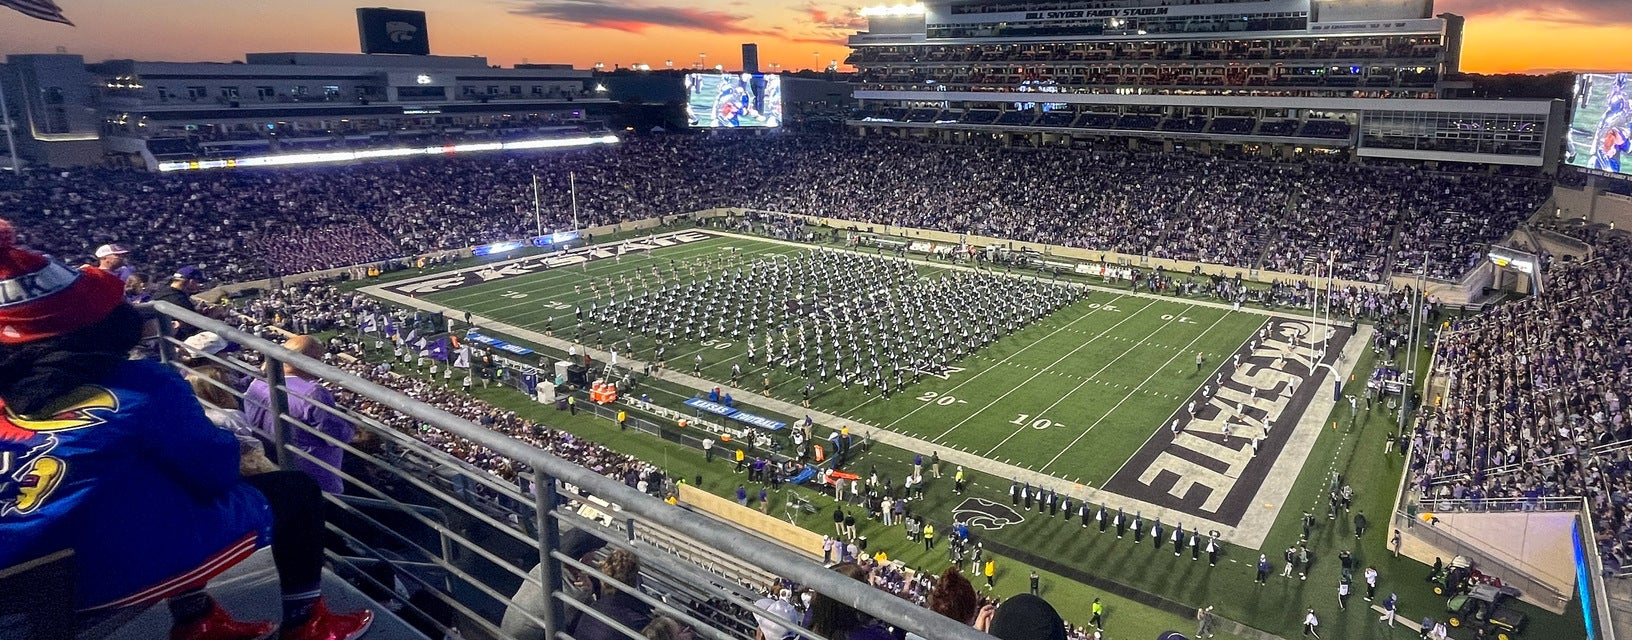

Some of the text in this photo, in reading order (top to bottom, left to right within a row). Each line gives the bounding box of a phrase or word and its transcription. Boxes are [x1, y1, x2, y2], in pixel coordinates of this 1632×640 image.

[1025, 7, 1168, 20] BILL SNYDER FAMILY STADIUM
[916, 391, 956, 406] 20
[1009, 413, 1052, 430] 10
